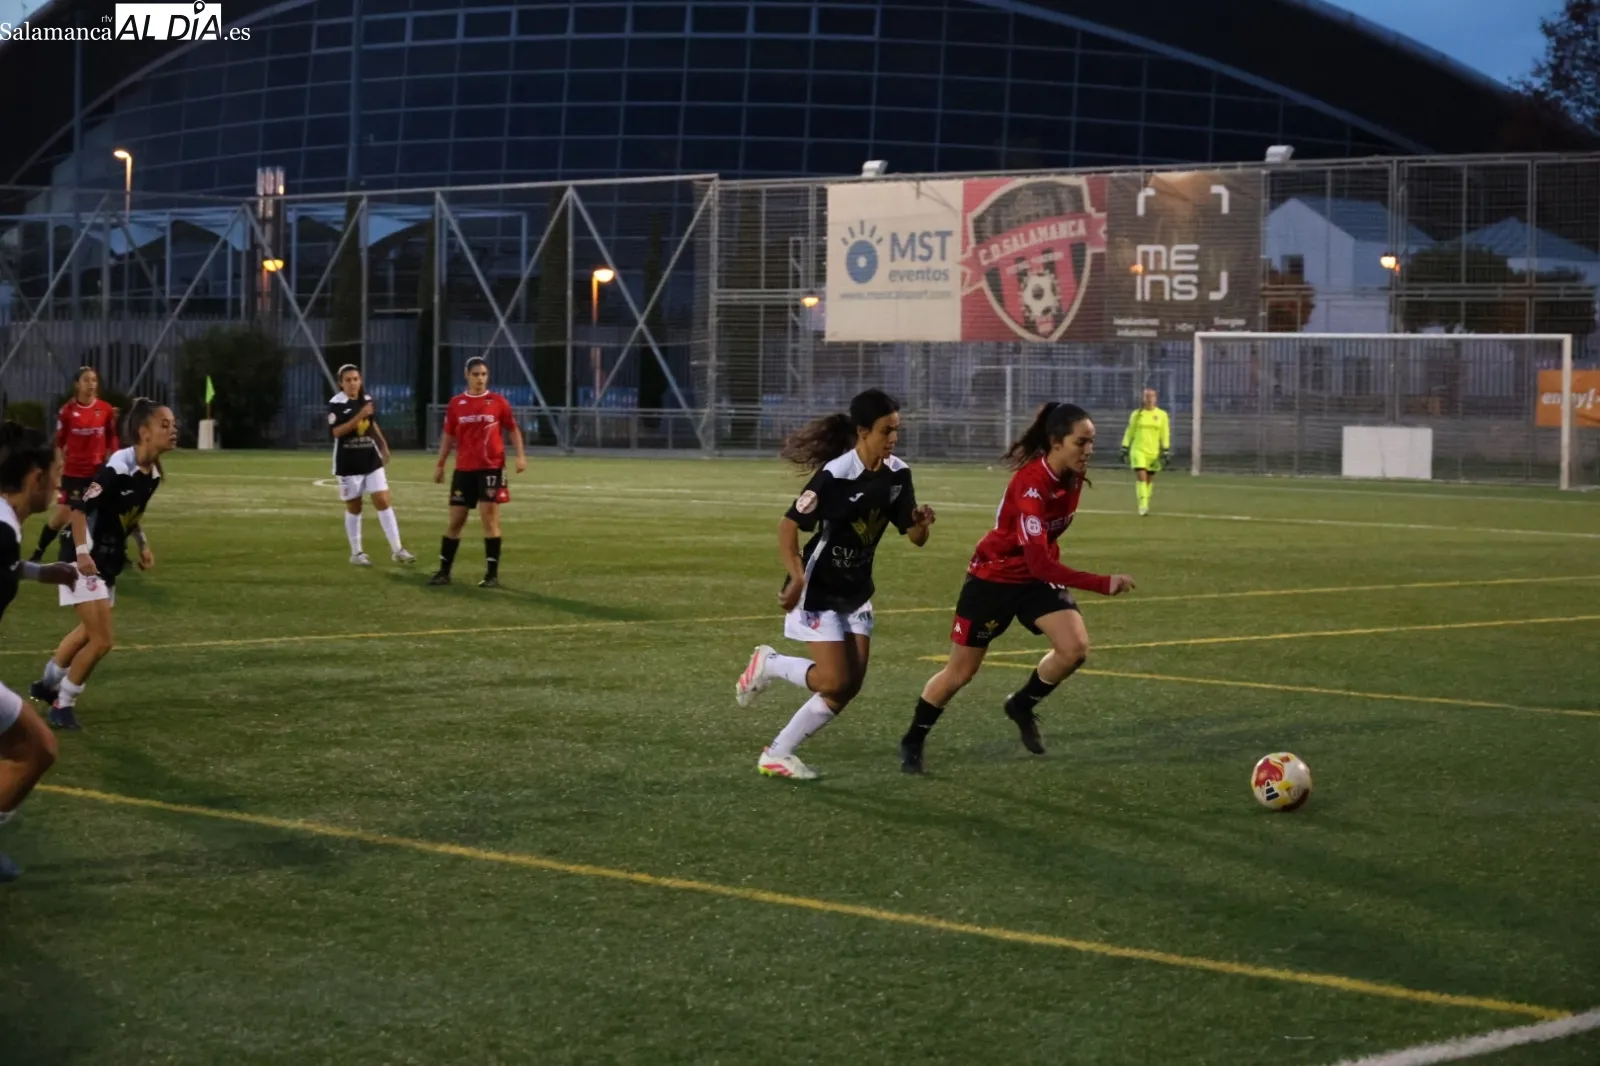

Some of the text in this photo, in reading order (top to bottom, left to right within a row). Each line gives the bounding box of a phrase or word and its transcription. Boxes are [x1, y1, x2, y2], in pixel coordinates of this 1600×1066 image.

[890, 230, 954, 263] MST
[888, 267, 950, 283] eventos
[486, 475, 497, 487] 17
